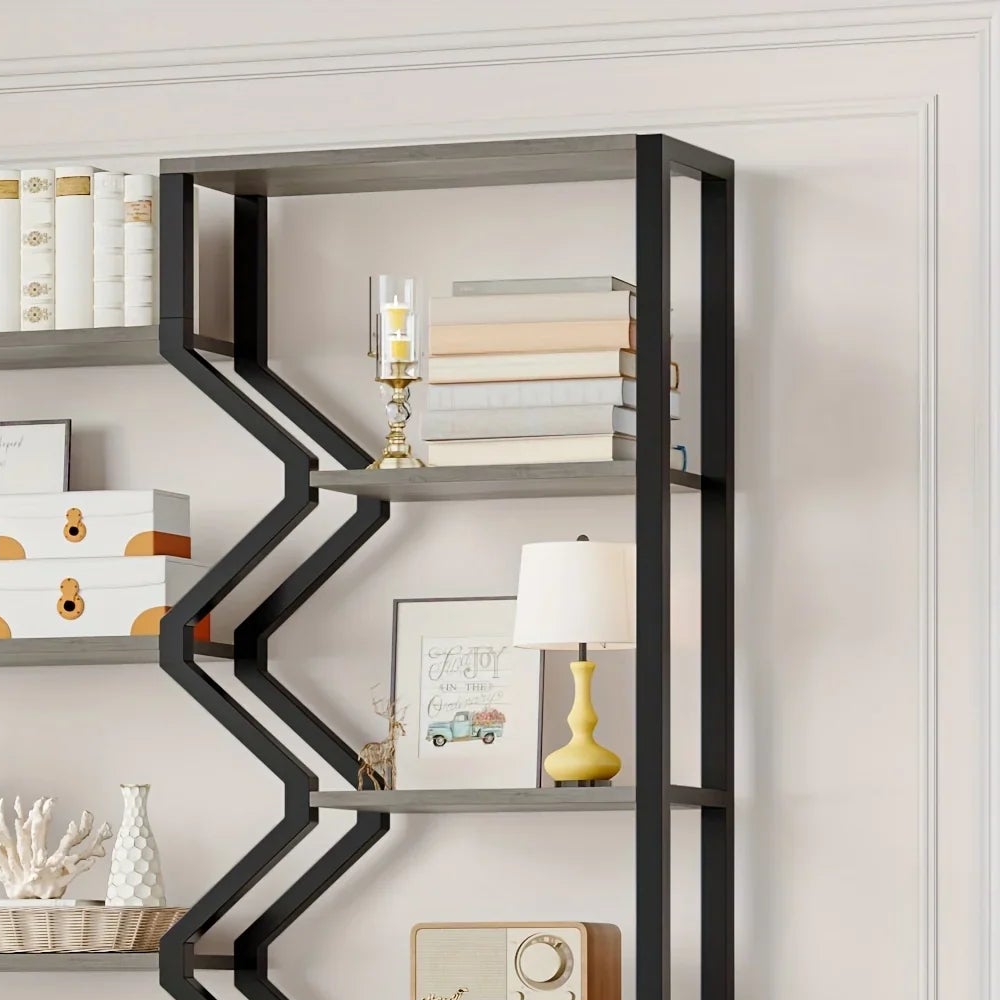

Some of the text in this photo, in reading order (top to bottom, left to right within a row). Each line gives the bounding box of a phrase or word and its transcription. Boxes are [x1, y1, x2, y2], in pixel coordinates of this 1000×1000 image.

[463, 646, 508, 680] JOY
[446, 683, 487, 691] IN THE
